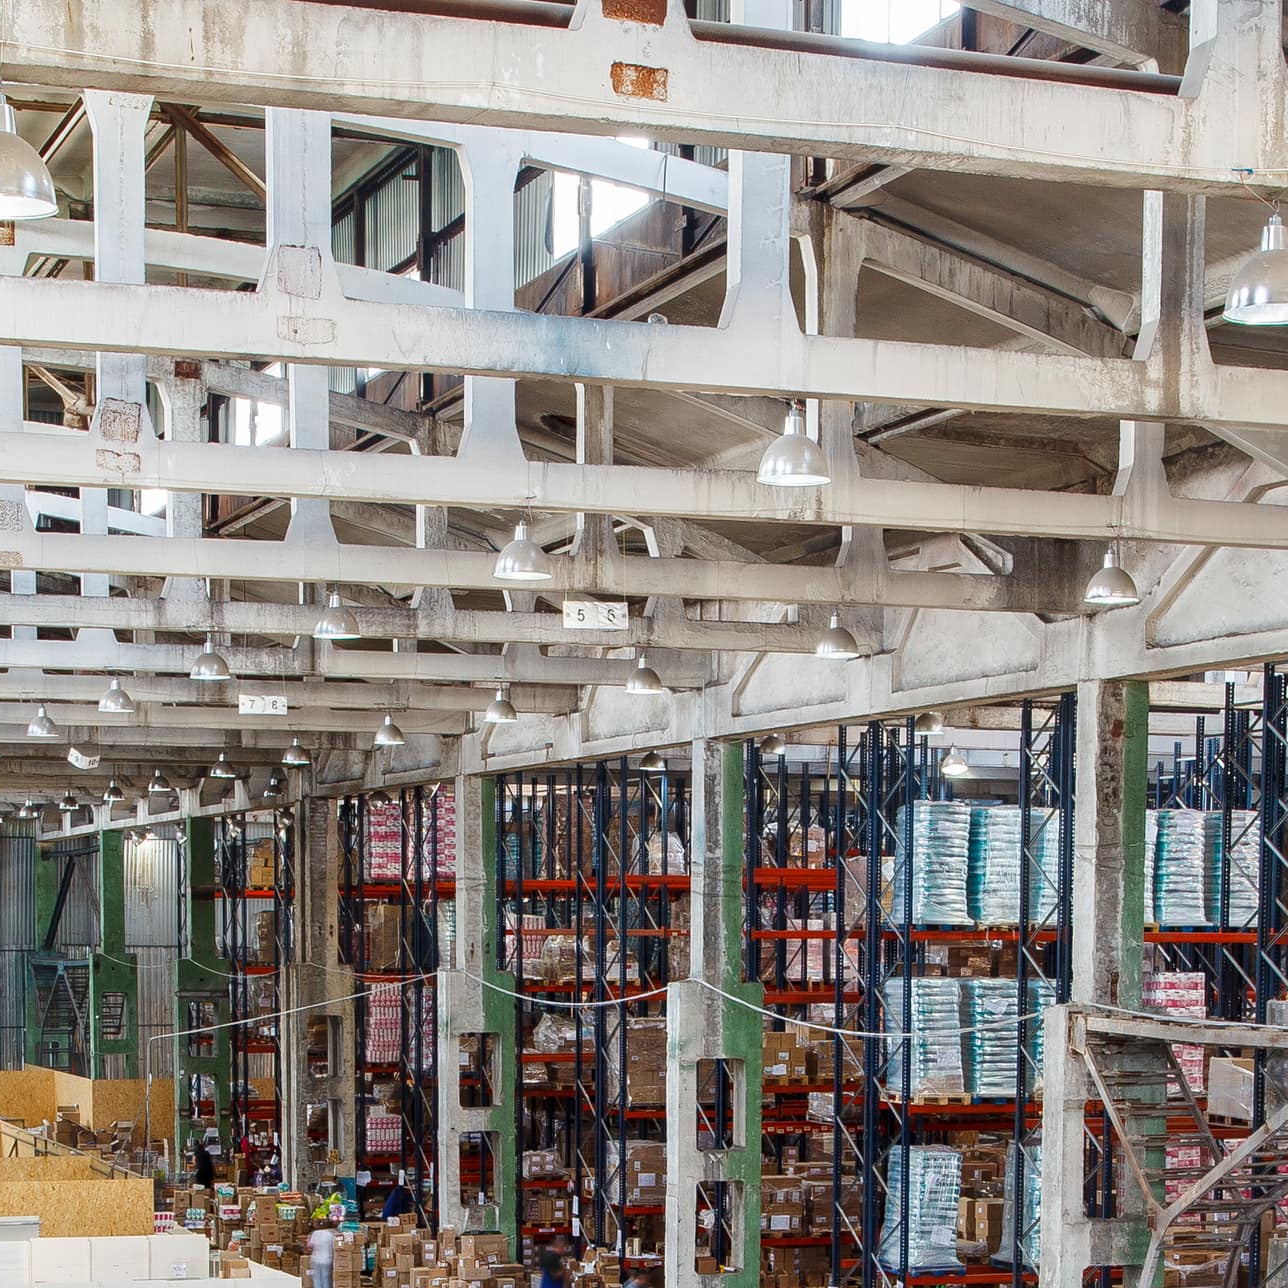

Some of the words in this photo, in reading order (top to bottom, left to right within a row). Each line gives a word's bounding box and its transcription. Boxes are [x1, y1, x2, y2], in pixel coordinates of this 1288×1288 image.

[577, 608, 585, 622] 5
[607, 608, 616, 622] 6
[249, 699, 255, 709] 7
[272, 700, 278, 710] 8
